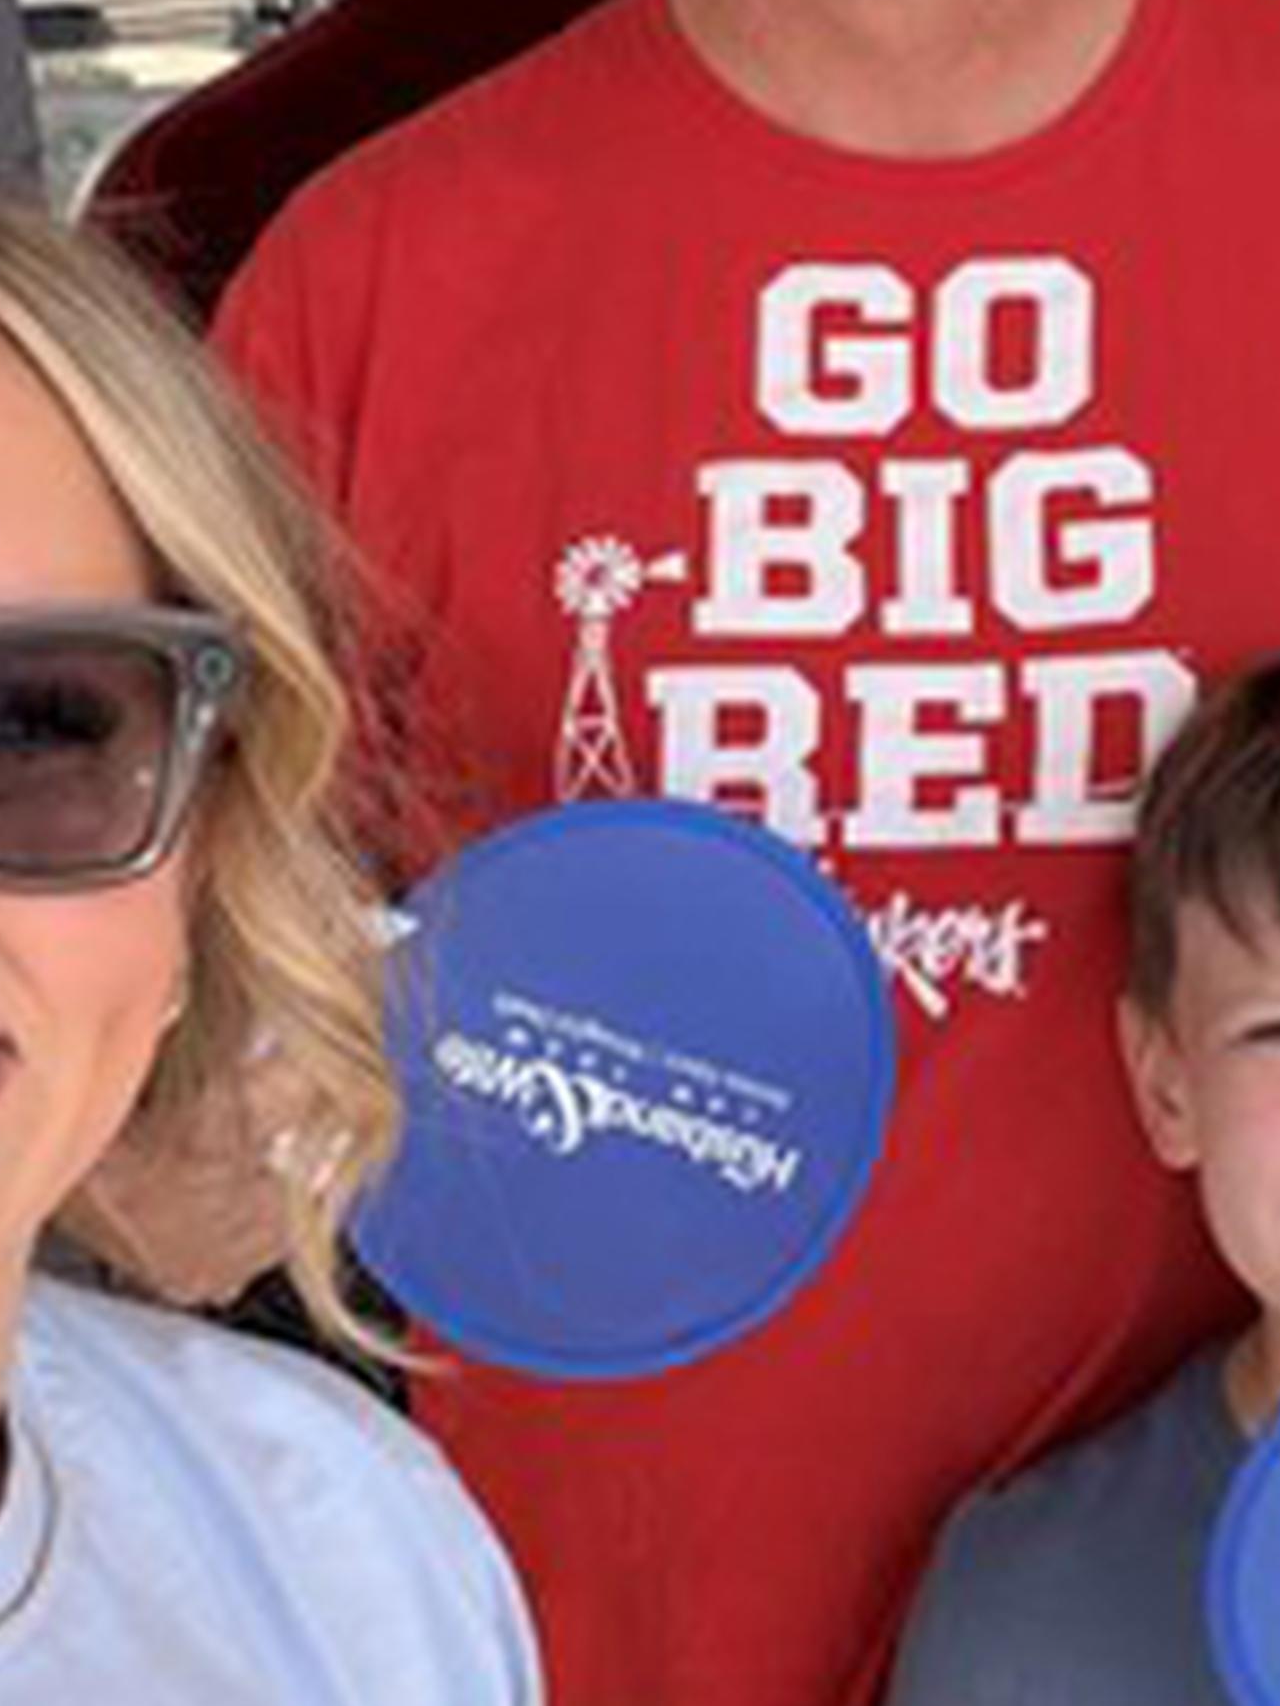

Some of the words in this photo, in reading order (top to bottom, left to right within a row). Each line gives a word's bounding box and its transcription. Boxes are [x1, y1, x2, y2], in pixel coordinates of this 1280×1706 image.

[754, 255, 1096, 437] GO
[690, 445, 1157, 636] BIG
[644, 647, 1197, 849] RED
